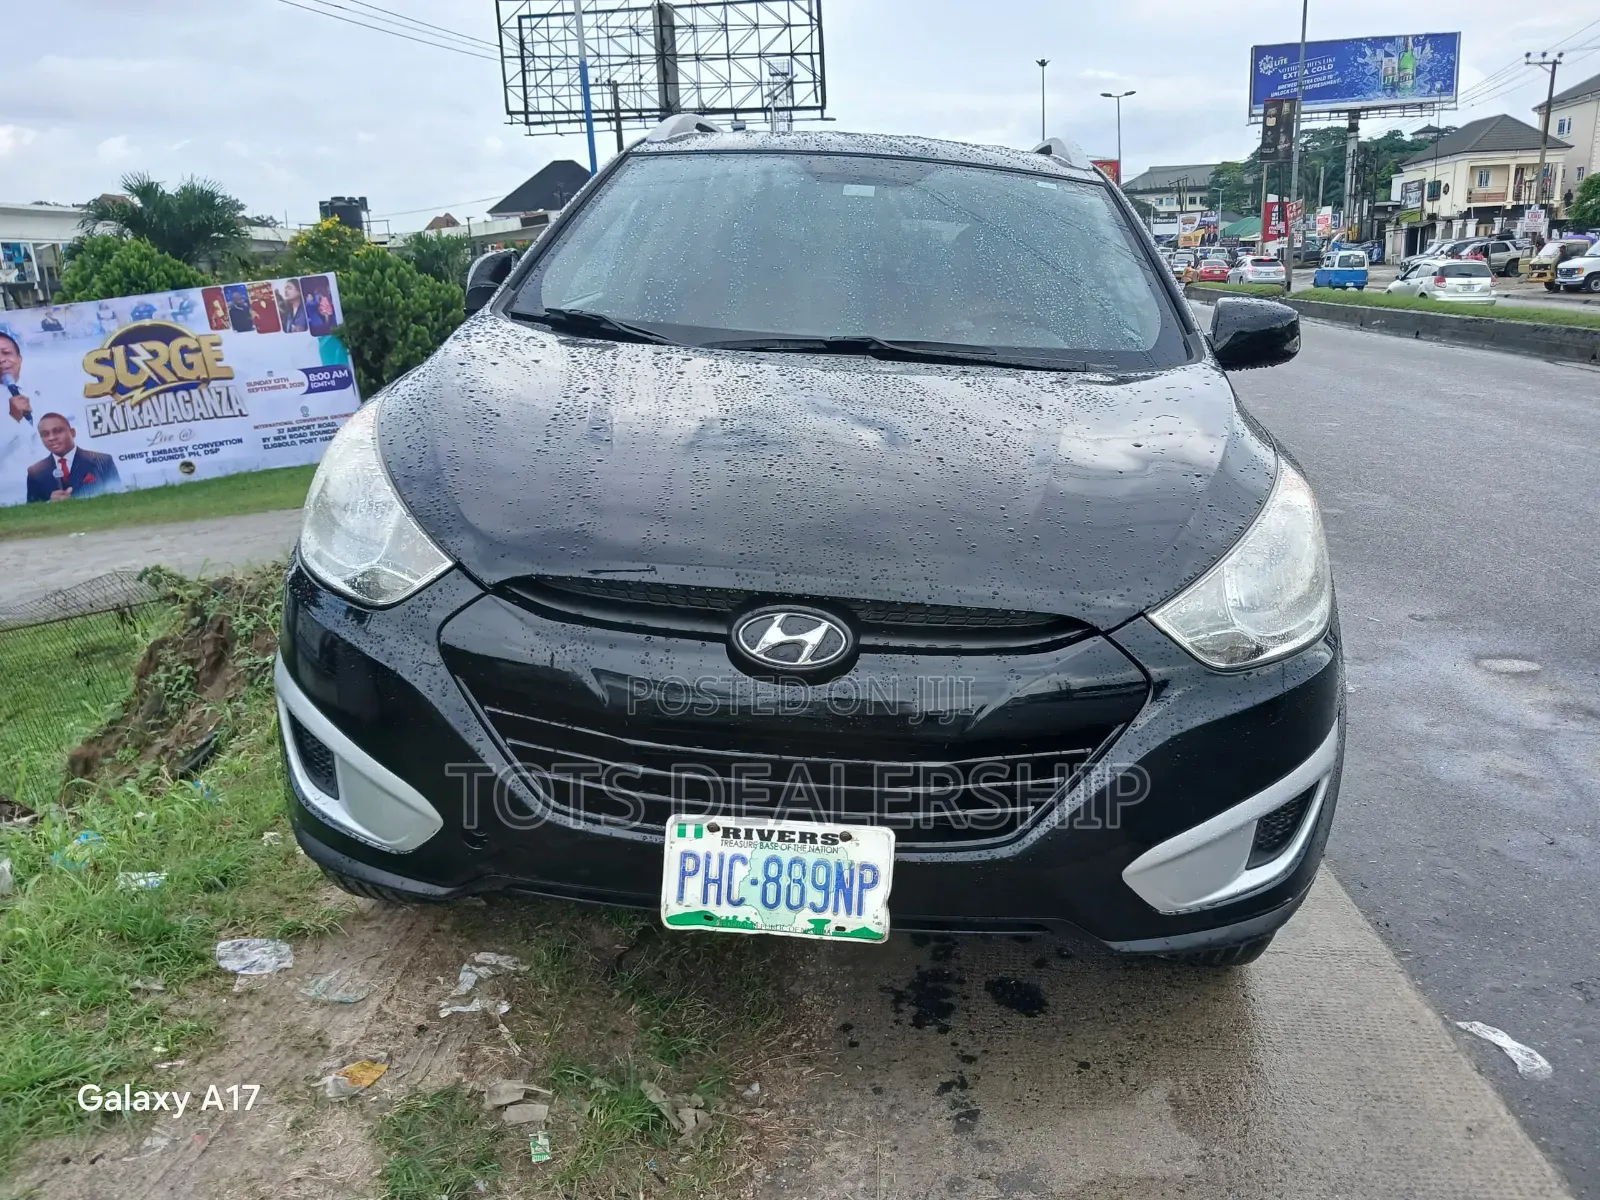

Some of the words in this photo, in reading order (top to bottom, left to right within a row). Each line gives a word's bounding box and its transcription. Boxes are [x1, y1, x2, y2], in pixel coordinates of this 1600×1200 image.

[1311, 63, 1334, 74] COLD
[82, 334, 235, 398] SURGE
[309, 371, 330, 381] 8:00
[332, 369, 349, 379] AM
[246, 378, 272, 388] SUNDAY
[85, 385, 249, 438] EXTRAVAGANZA
[253, 421, 294, 430] INTERNATIONAL
[295, 416, 329, 424] CONVENTION
[287, 424, 315, 433] AIRPORT
[146, 430, 174, 447] Live
[179, 428, 195, 442] @
[289, 432, 308, 440] ROAD
[119, 451, 150, 462] CHRIST
[152, 445, 189, 457] EMBASSY
[192, 437, 244, 450] CONVENTION
[146, 453, 186, 464] GROUNDS
[188, 450, 202, 458] PH,
[203, 448, 220, 456] DSP
[721, 826, 840, 846] RIVERS
[720, 839, 758, 849] TREASURE
[759, 842, 779, 851] BASE
[780, 843, 792, 851] OF
[792, 844, 807, 853] THE
[808, 845, 839, 854] NATION
